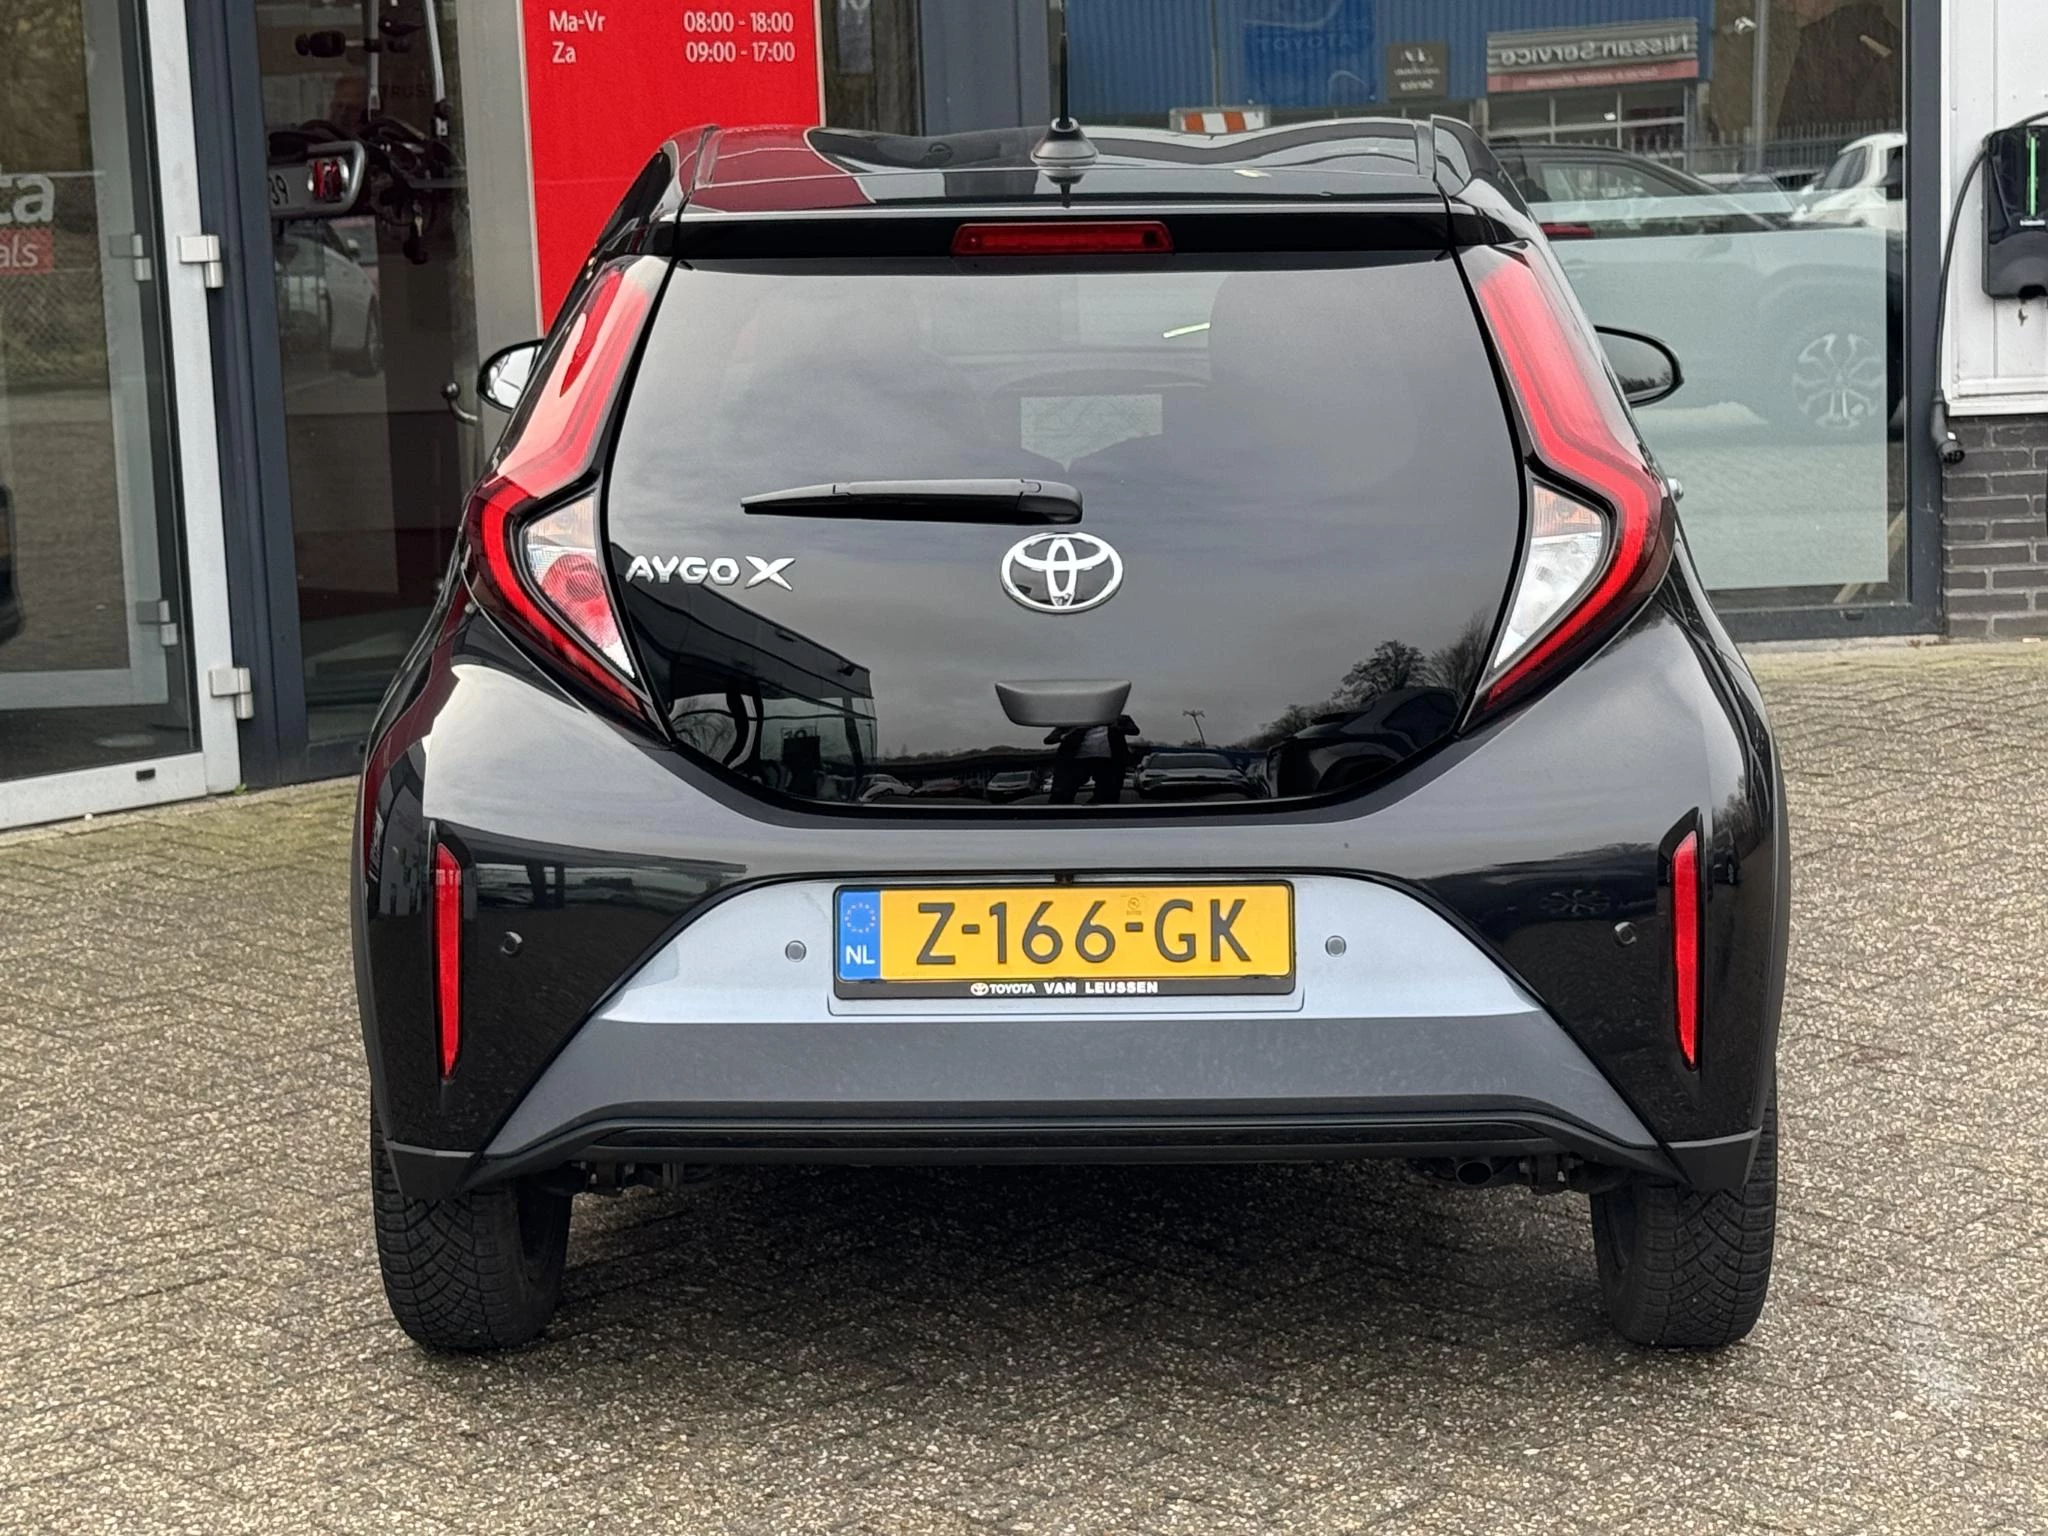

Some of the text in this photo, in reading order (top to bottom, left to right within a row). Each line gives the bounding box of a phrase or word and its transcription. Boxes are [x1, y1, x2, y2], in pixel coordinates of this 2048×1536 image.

[549, 10, 605, 32] Ma-Vr
[683, 11, 734, 33] 08:00
[750, 12, 794, 33] 18:00
[552, 41, 577, 63] Za
[686, 41, 737, 63] 09:00
[752, 41, 795, 62] 17:00
[625, 555, 796, 591] AYGO X
[915, 898, 1252, 966] Z-166-GK
[845, 946, 875, 965] NL
[989, 981, 1159, 995] TOYOTA VAN LEUSSEN
